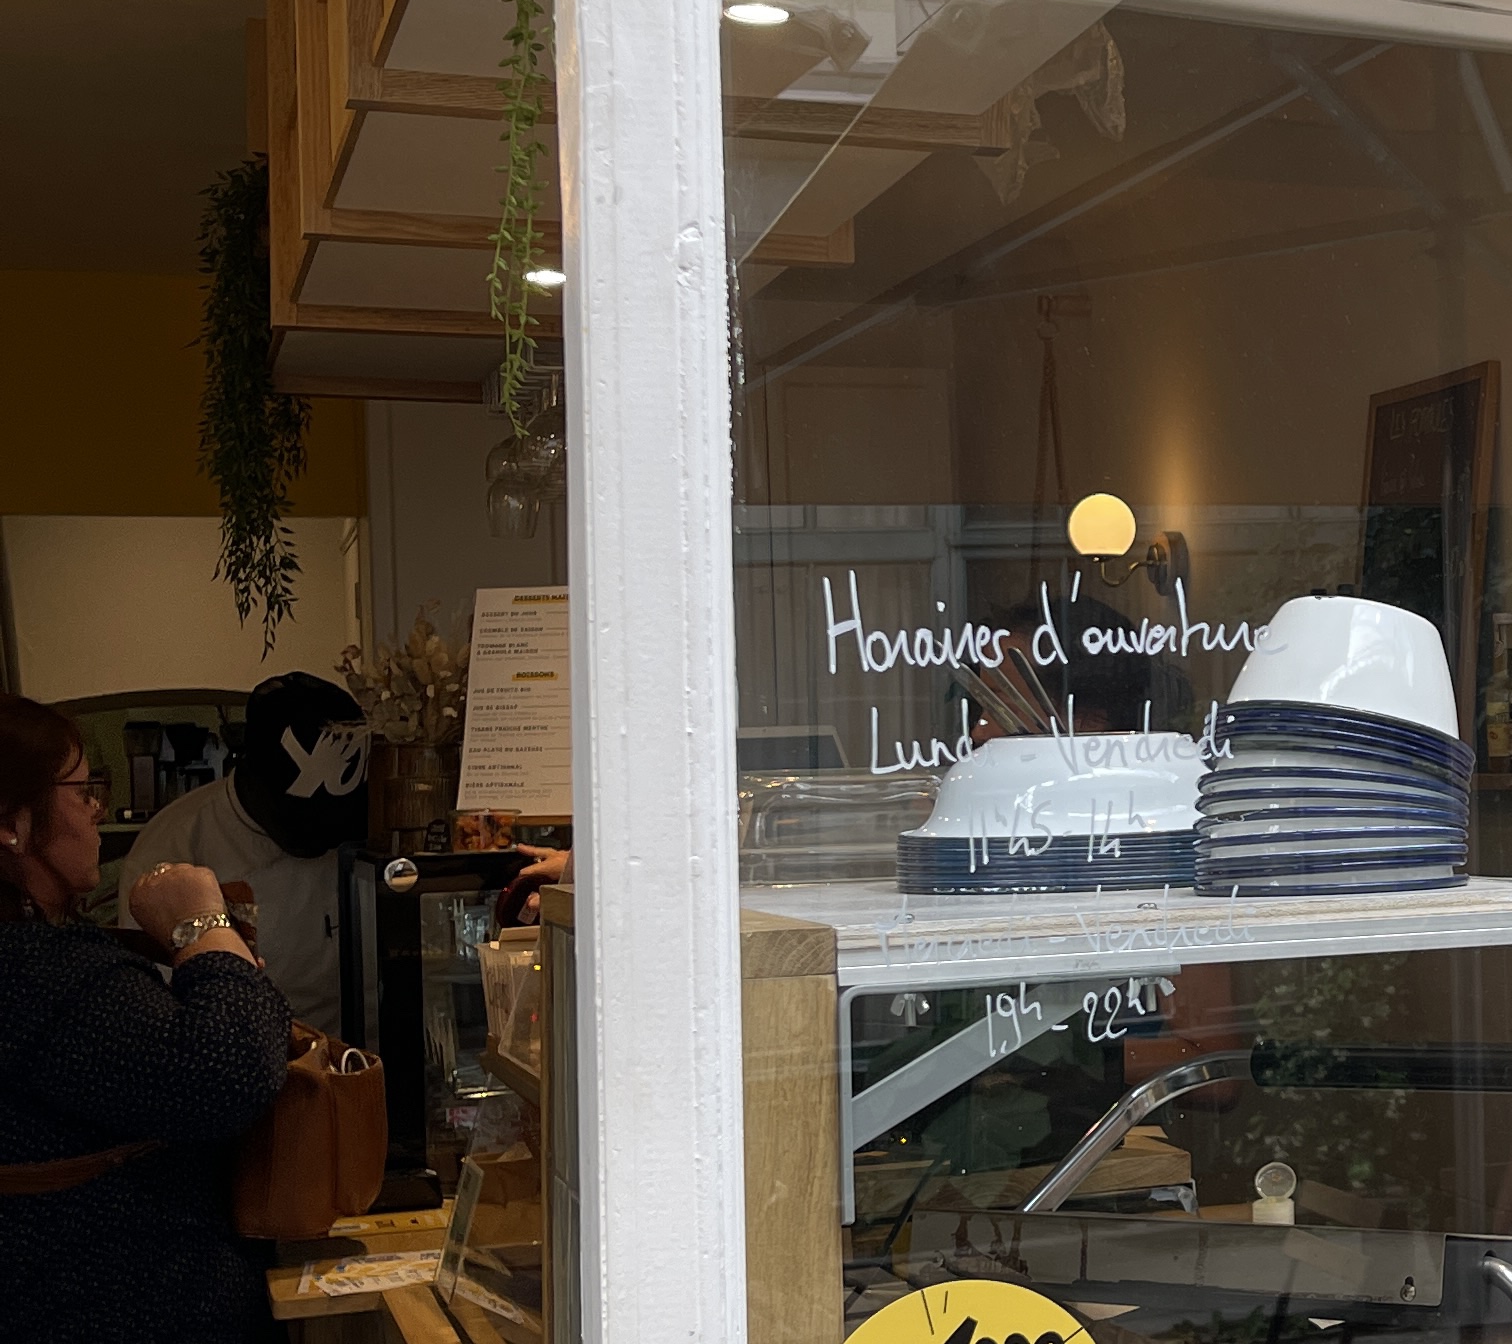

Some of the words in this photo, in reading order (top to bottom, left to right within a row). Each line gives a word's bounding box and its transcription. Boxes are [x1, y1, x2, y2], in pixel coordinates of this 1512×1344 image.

[821, 568, 1013, 675] Horaires
[1030, 570, 1288, 667] d'ouverture
[869, 697, 996, 775] Lundi
[1050, 692, 1236, 775] Vendredi
[1073, 883, 1259, 955] Vendredi
